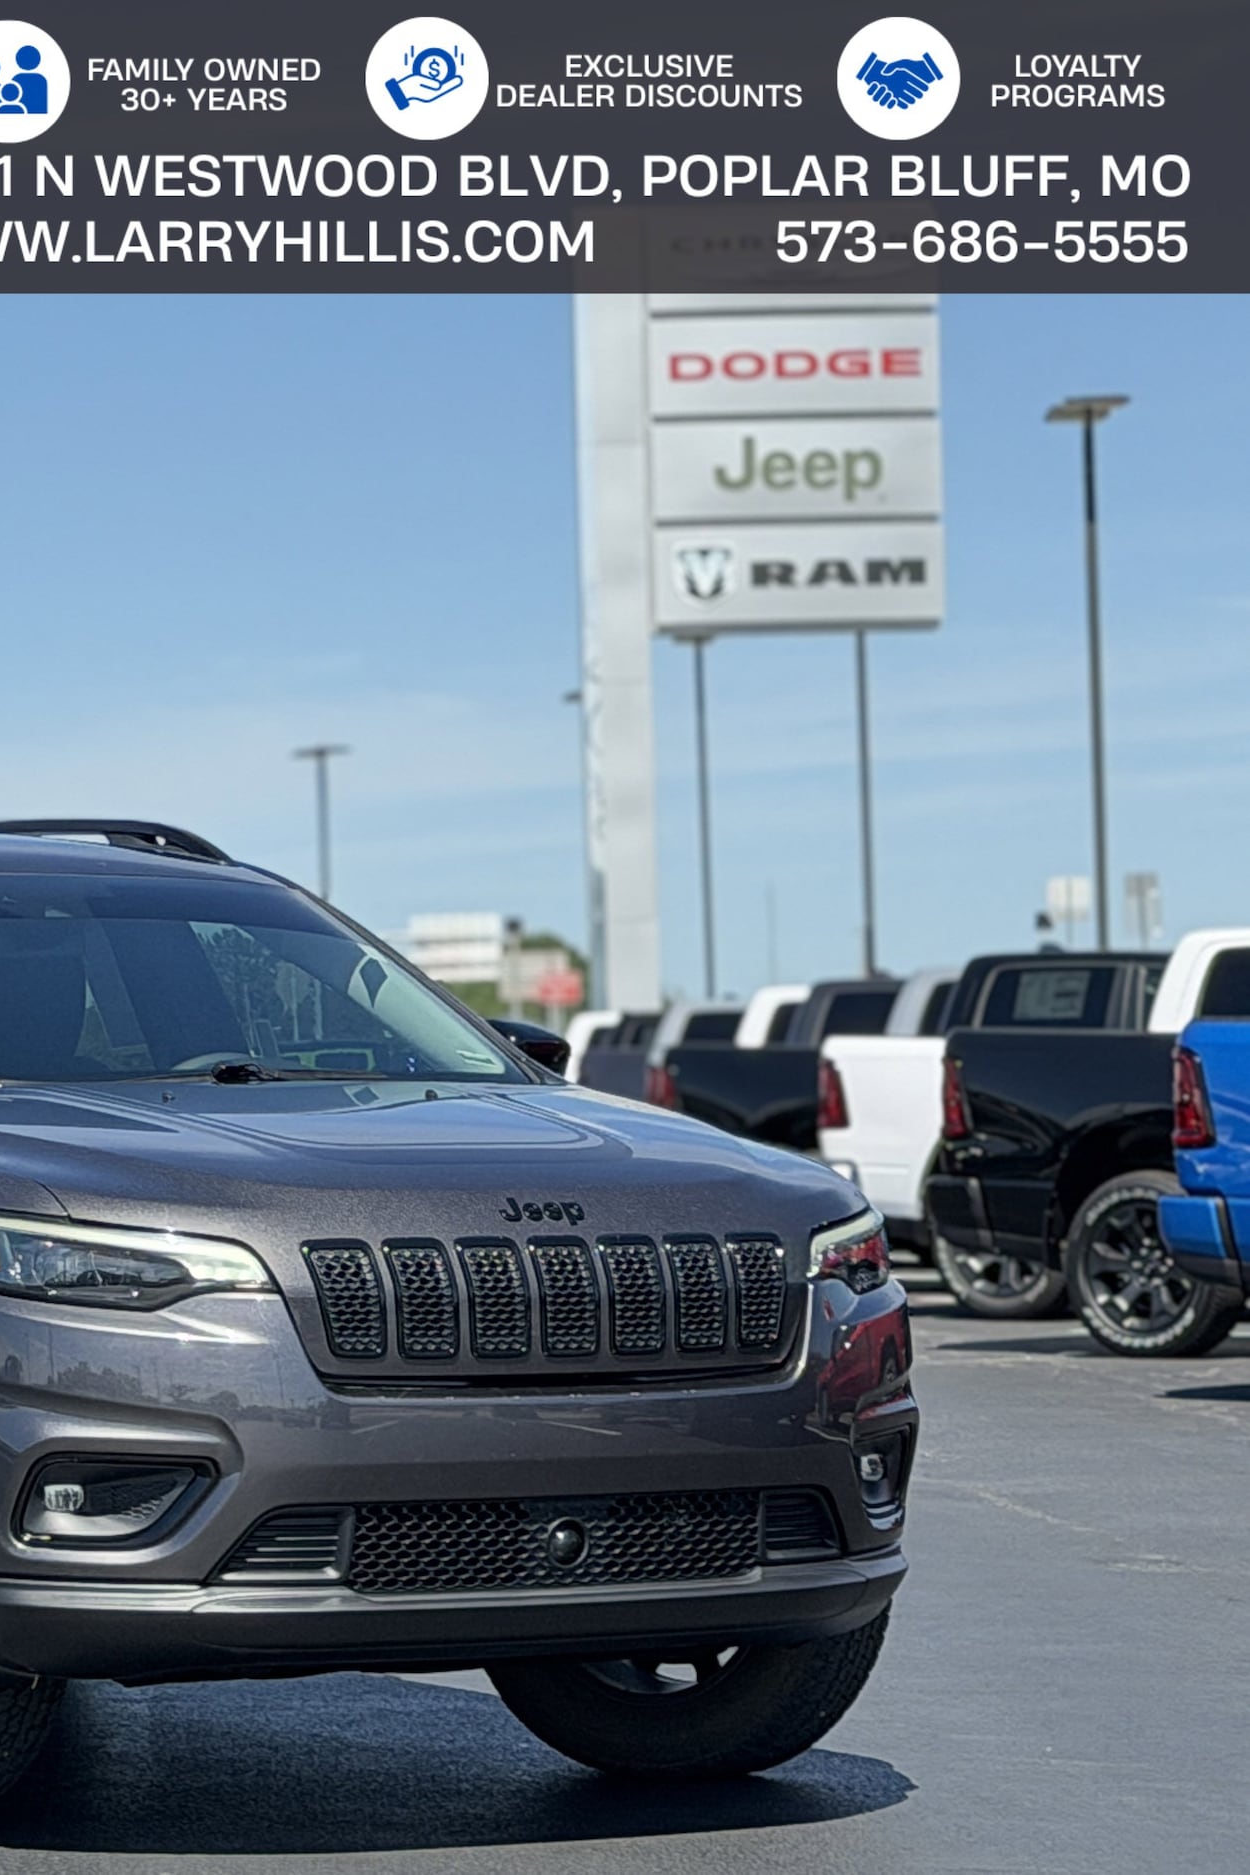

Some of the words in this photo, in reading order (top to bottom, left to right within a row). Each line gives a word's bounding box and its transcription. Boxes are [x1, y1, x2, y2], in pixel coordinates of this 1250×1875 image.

[669, 349, 922, 382] DODGE
[713, 435, 883, 502] Jeep
[751, 557, 928, 588] RAM
[499, 1197, 585, 1226] Jeep
